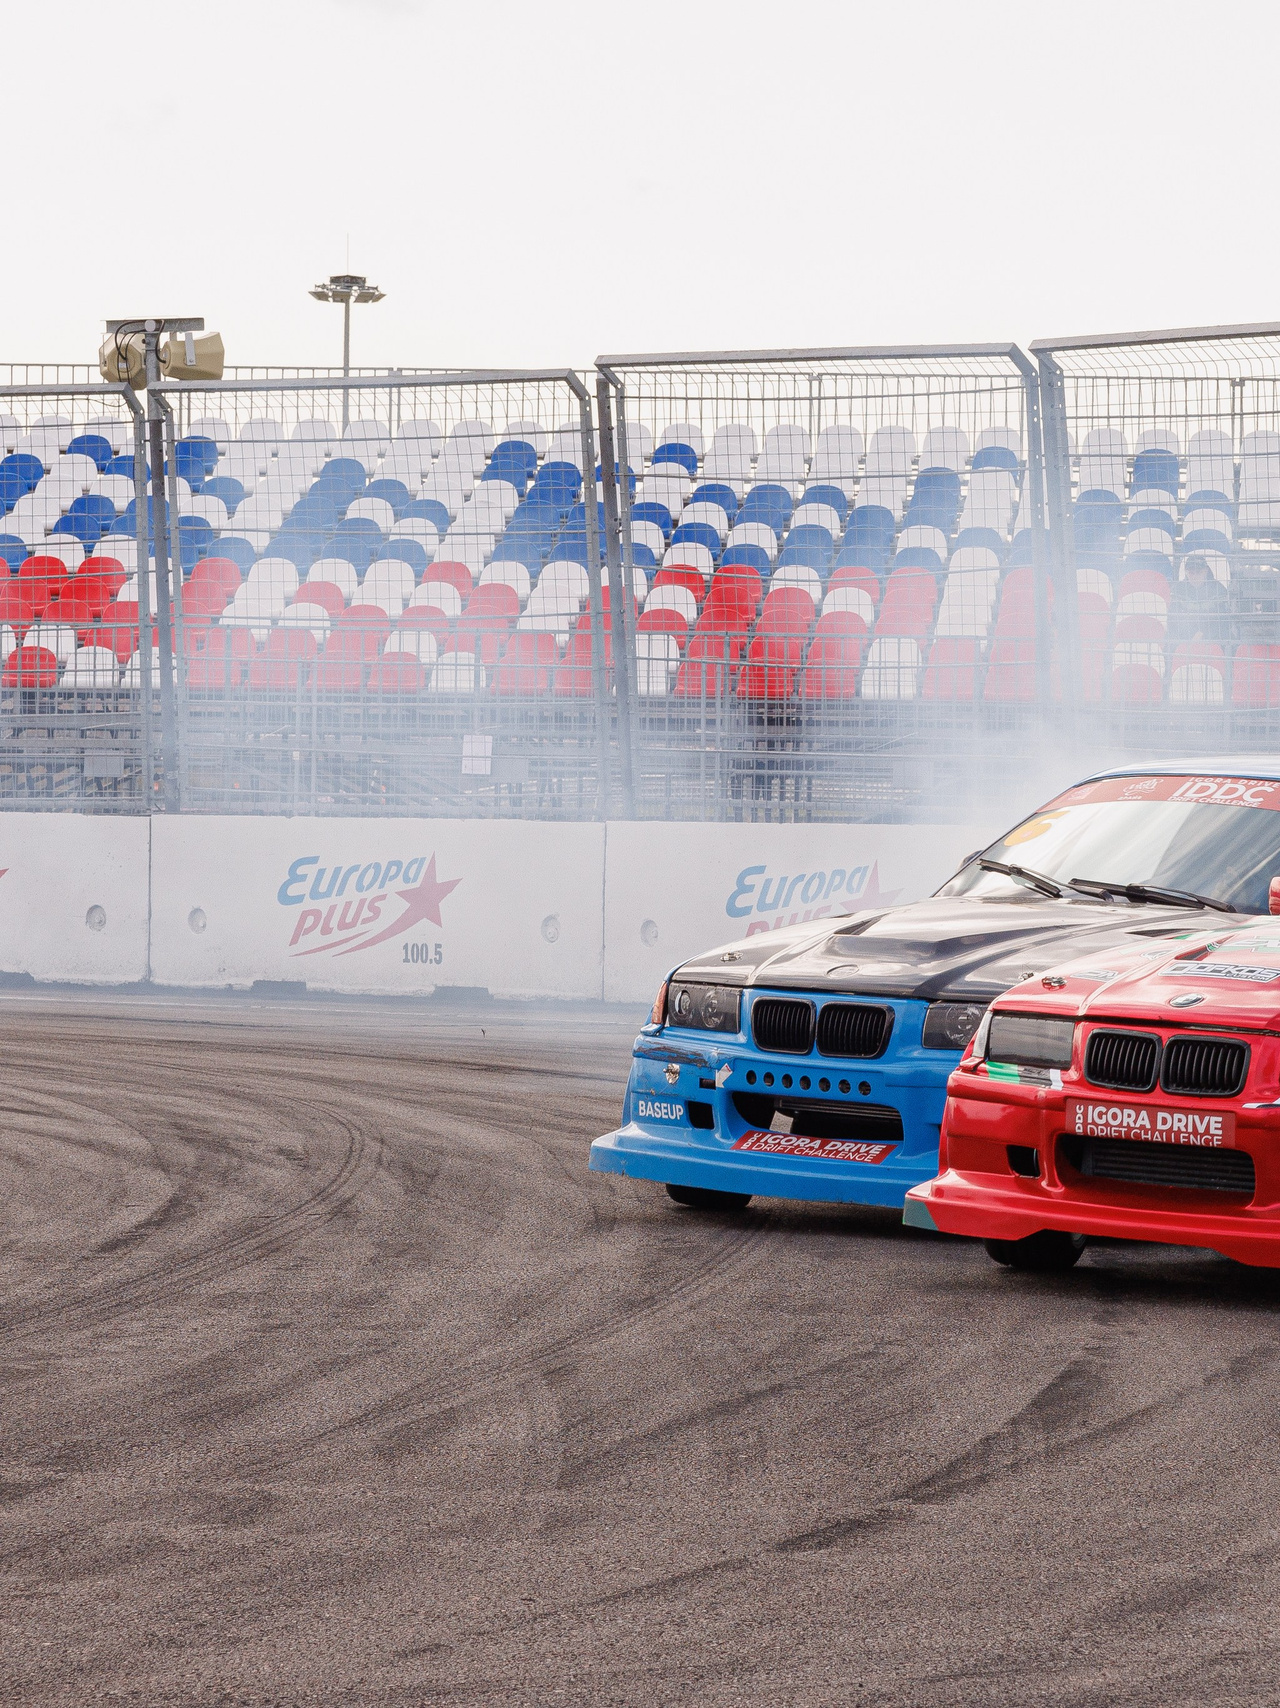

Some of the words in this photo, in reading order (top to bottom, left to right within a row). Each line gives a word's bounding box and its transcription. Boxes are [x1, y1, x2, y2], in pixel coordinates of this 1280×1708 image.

[1171, 781, 1275, 802] IDDC
[1198, 796, 1261, 808] CHALLENGE
[276, 855, 428, 907] Europa
[725, 864, 870, 919] Europa
[402, 942, 443, 965] 100.5
[638, 1100, 684, 1120] BASEUP
[1075, 1104, 1084, 1135] DDC
[1087, 1105, 1152, 1129] IGORA
[1156, 1111, 1223, 1135] DRIVE
[760, 1133, 818, 1149] IGORA
[824, 1140, 886, 1155] DRIVE
[1087, 1124, 1128, 1138] DRIFT
[1130, 1128, 1223, 1147] CHALLENGE
[752, 1142, 792, 1154] DRIFT
[794, 1145, 877, 1163] CHALLENGE
